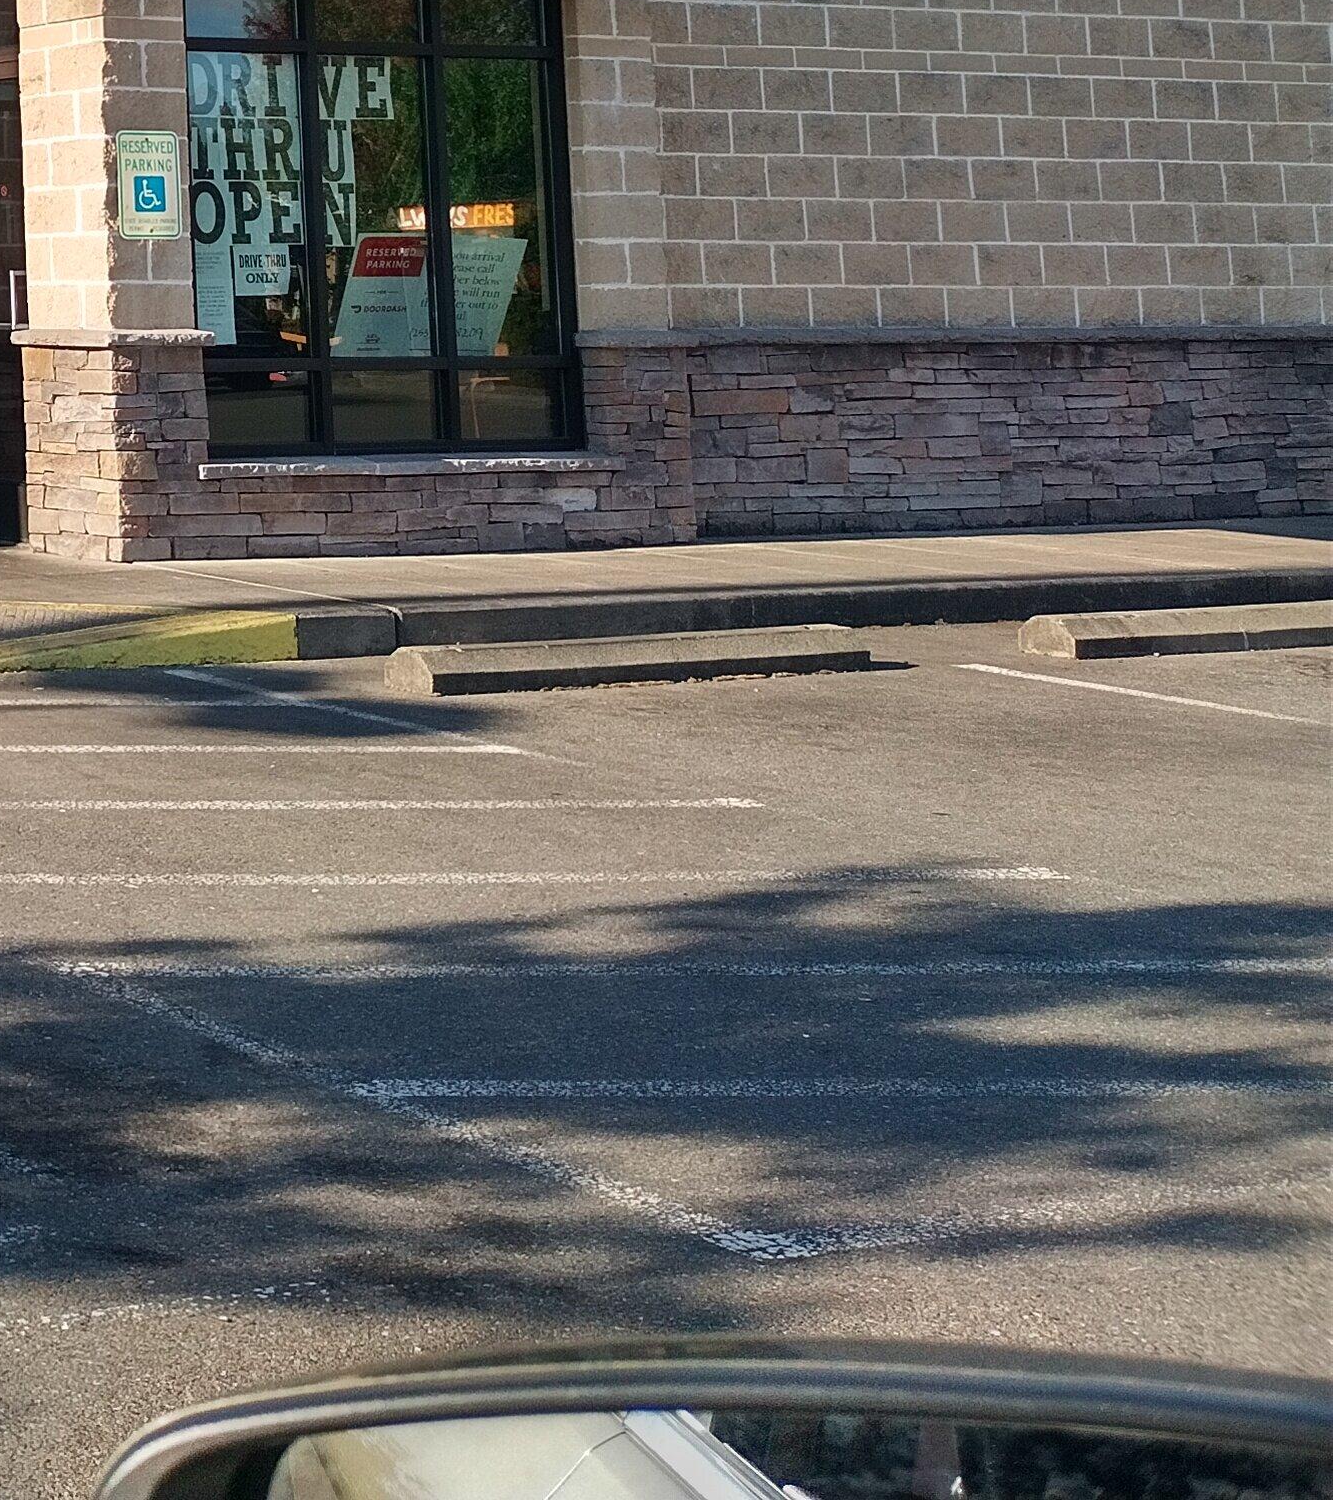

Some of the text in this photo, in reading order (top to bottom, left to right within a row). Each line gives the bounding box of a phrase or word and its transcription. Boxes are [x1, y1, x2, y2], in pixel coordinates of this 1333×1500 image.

[189, 53, 389, 118] DRIVE
[121, 140, 174, 154] RESERVED
[191, 116, 347, 182] THRU
[125, 159, 173, 172] PARKING
[190, 181, 355, 246] OPEN
[366, 247, 417, 257] RESERVED
[471, 252, 506, 263] arrival
[239, 254, 263, 269] DRIVE
[265, 254, 287, 268] THRU
[366, 260, 411, 269] PARKING
[453, 263, 496, 273] ease call
[245, 272, 280, 284] ONLY
[462, 288, 480, 298] will
[482, 290, 501, 298] run
[363, 305, 407, 313] DOORDASH
